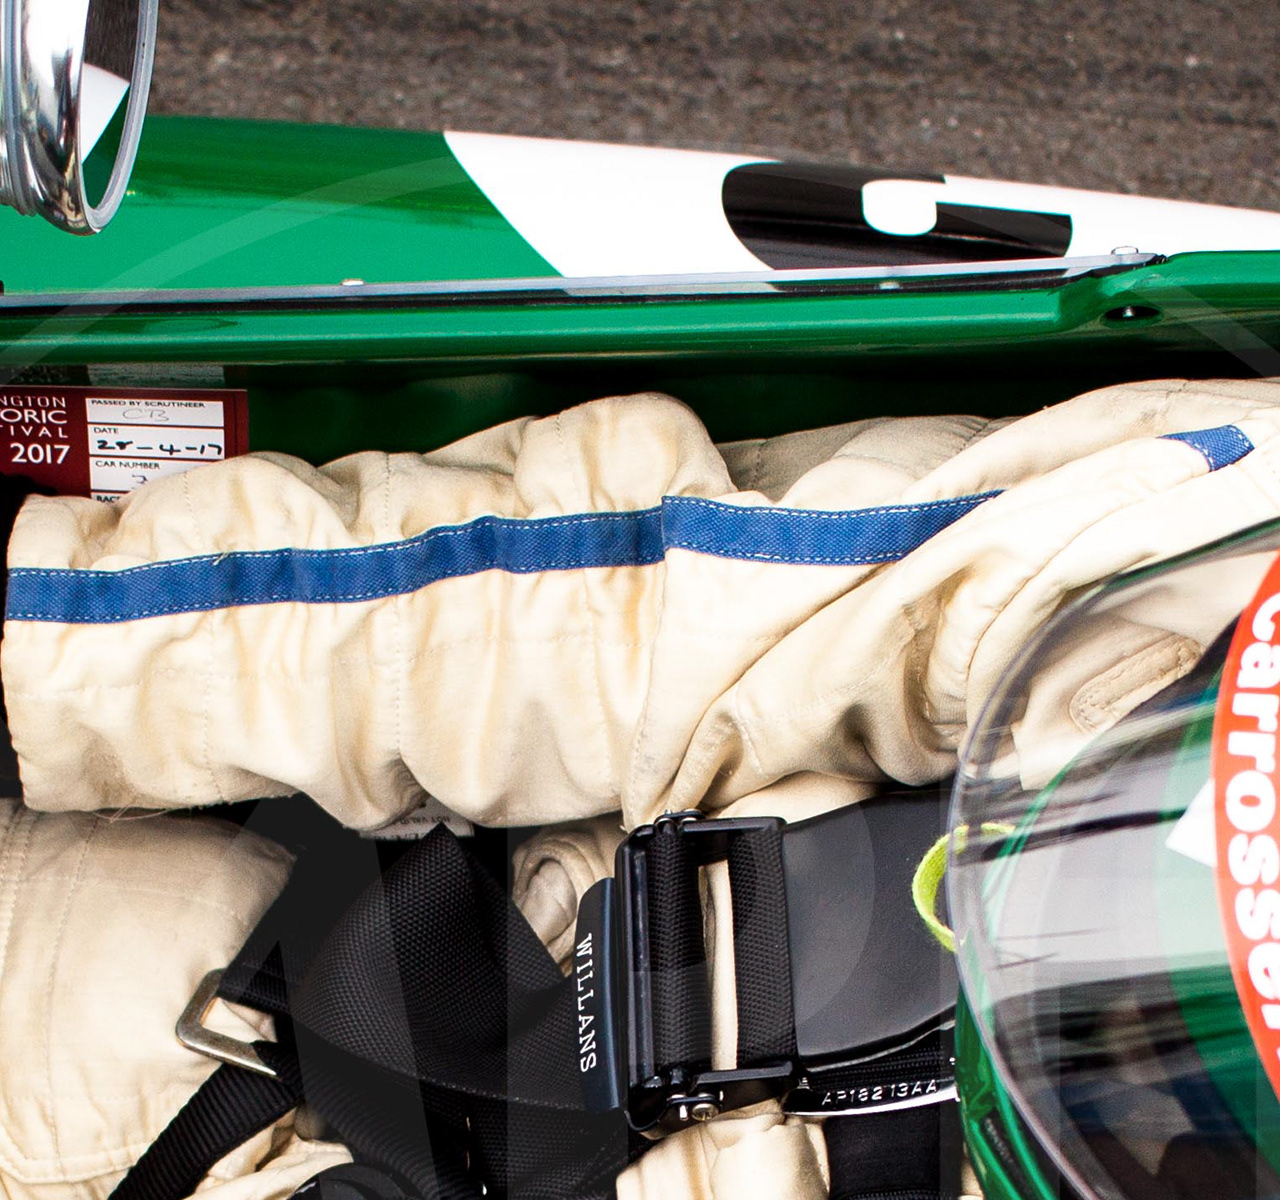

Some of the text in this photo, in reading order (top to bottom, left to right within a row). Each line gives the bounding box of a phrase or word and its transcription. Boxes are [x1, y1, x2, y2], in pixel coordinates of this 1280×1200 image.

[11, 443, 70, 464] 2017
[95, 460, 160, 470] CAR NUMBER
[96, 495, 121, 503] RAC
[575, 932, 599, 1073] WILLANS
